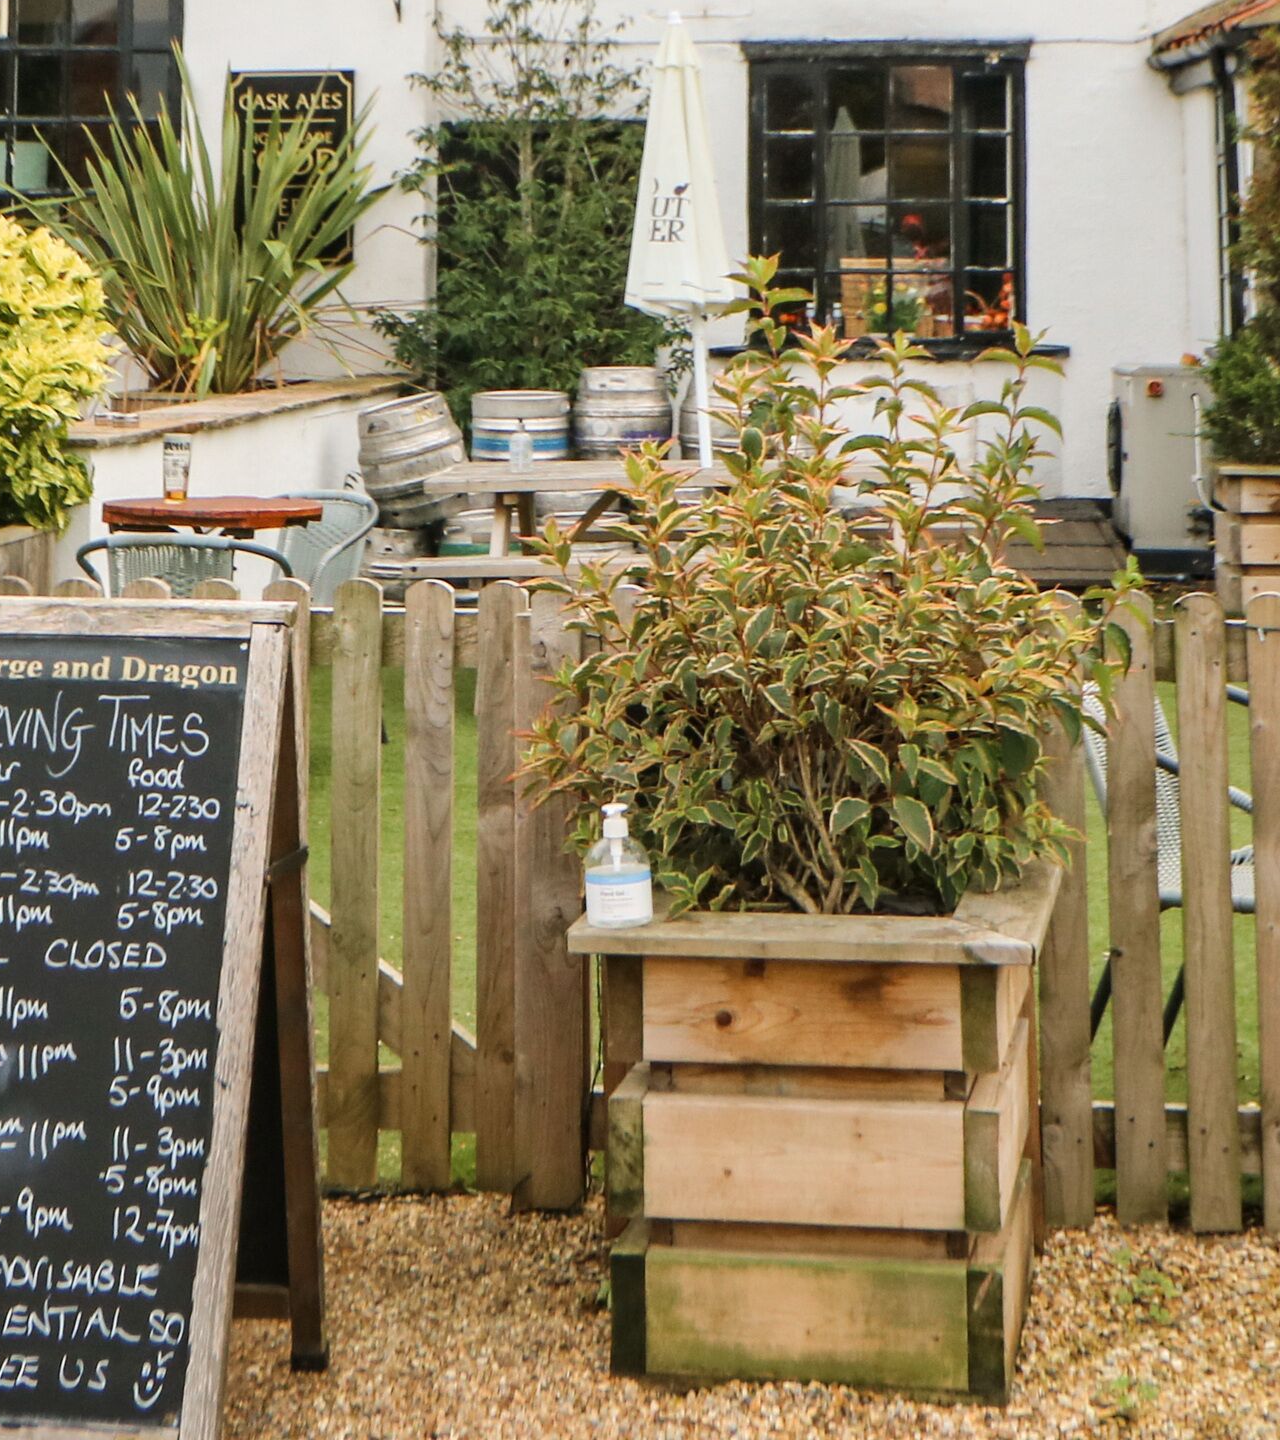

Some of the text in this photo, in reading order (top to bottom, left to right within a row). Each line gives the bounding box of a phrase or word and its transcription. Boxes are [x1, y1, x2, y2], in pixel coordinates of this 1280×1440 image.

[238, 92, 343, 110] CASK ALES
[51, 655, 111, 681] and
[120, 656, 238, 690] Dragon
[98, 694, 210, 759] TIMES
[127, 757, 185, 789] food
[44, 938, 167, 970] CLOSED
[148, 1309, 185, 1346] SO
[59, 1354, 110, 1391] US
